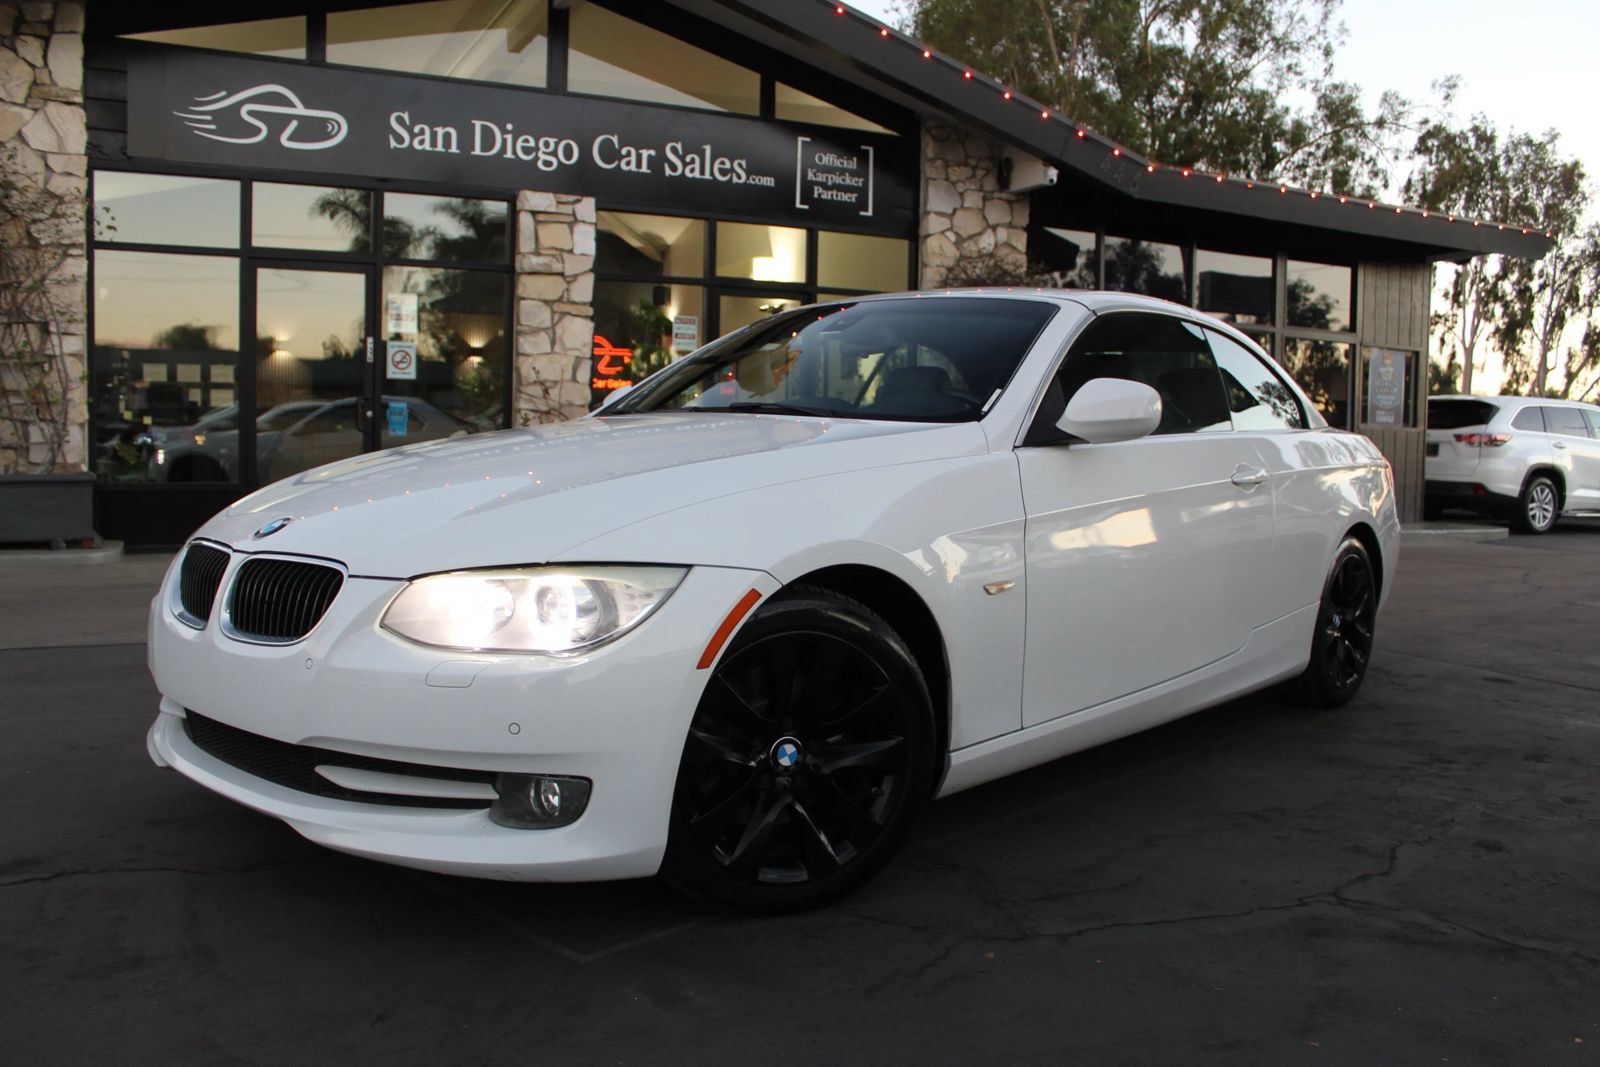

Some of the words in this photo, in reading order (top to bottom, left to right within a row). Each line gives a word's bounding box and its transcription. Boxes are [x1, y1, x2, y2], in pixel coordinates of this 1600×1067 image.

[389, 111, 460, 154] San
[471, 119, 580, 172] Diego
[592, 134, 657, 174] Car
[814, 152, 858, 169] Official
[806, 168, 865, 188] Karpicker
[813, 185, 859, 203] Partner
